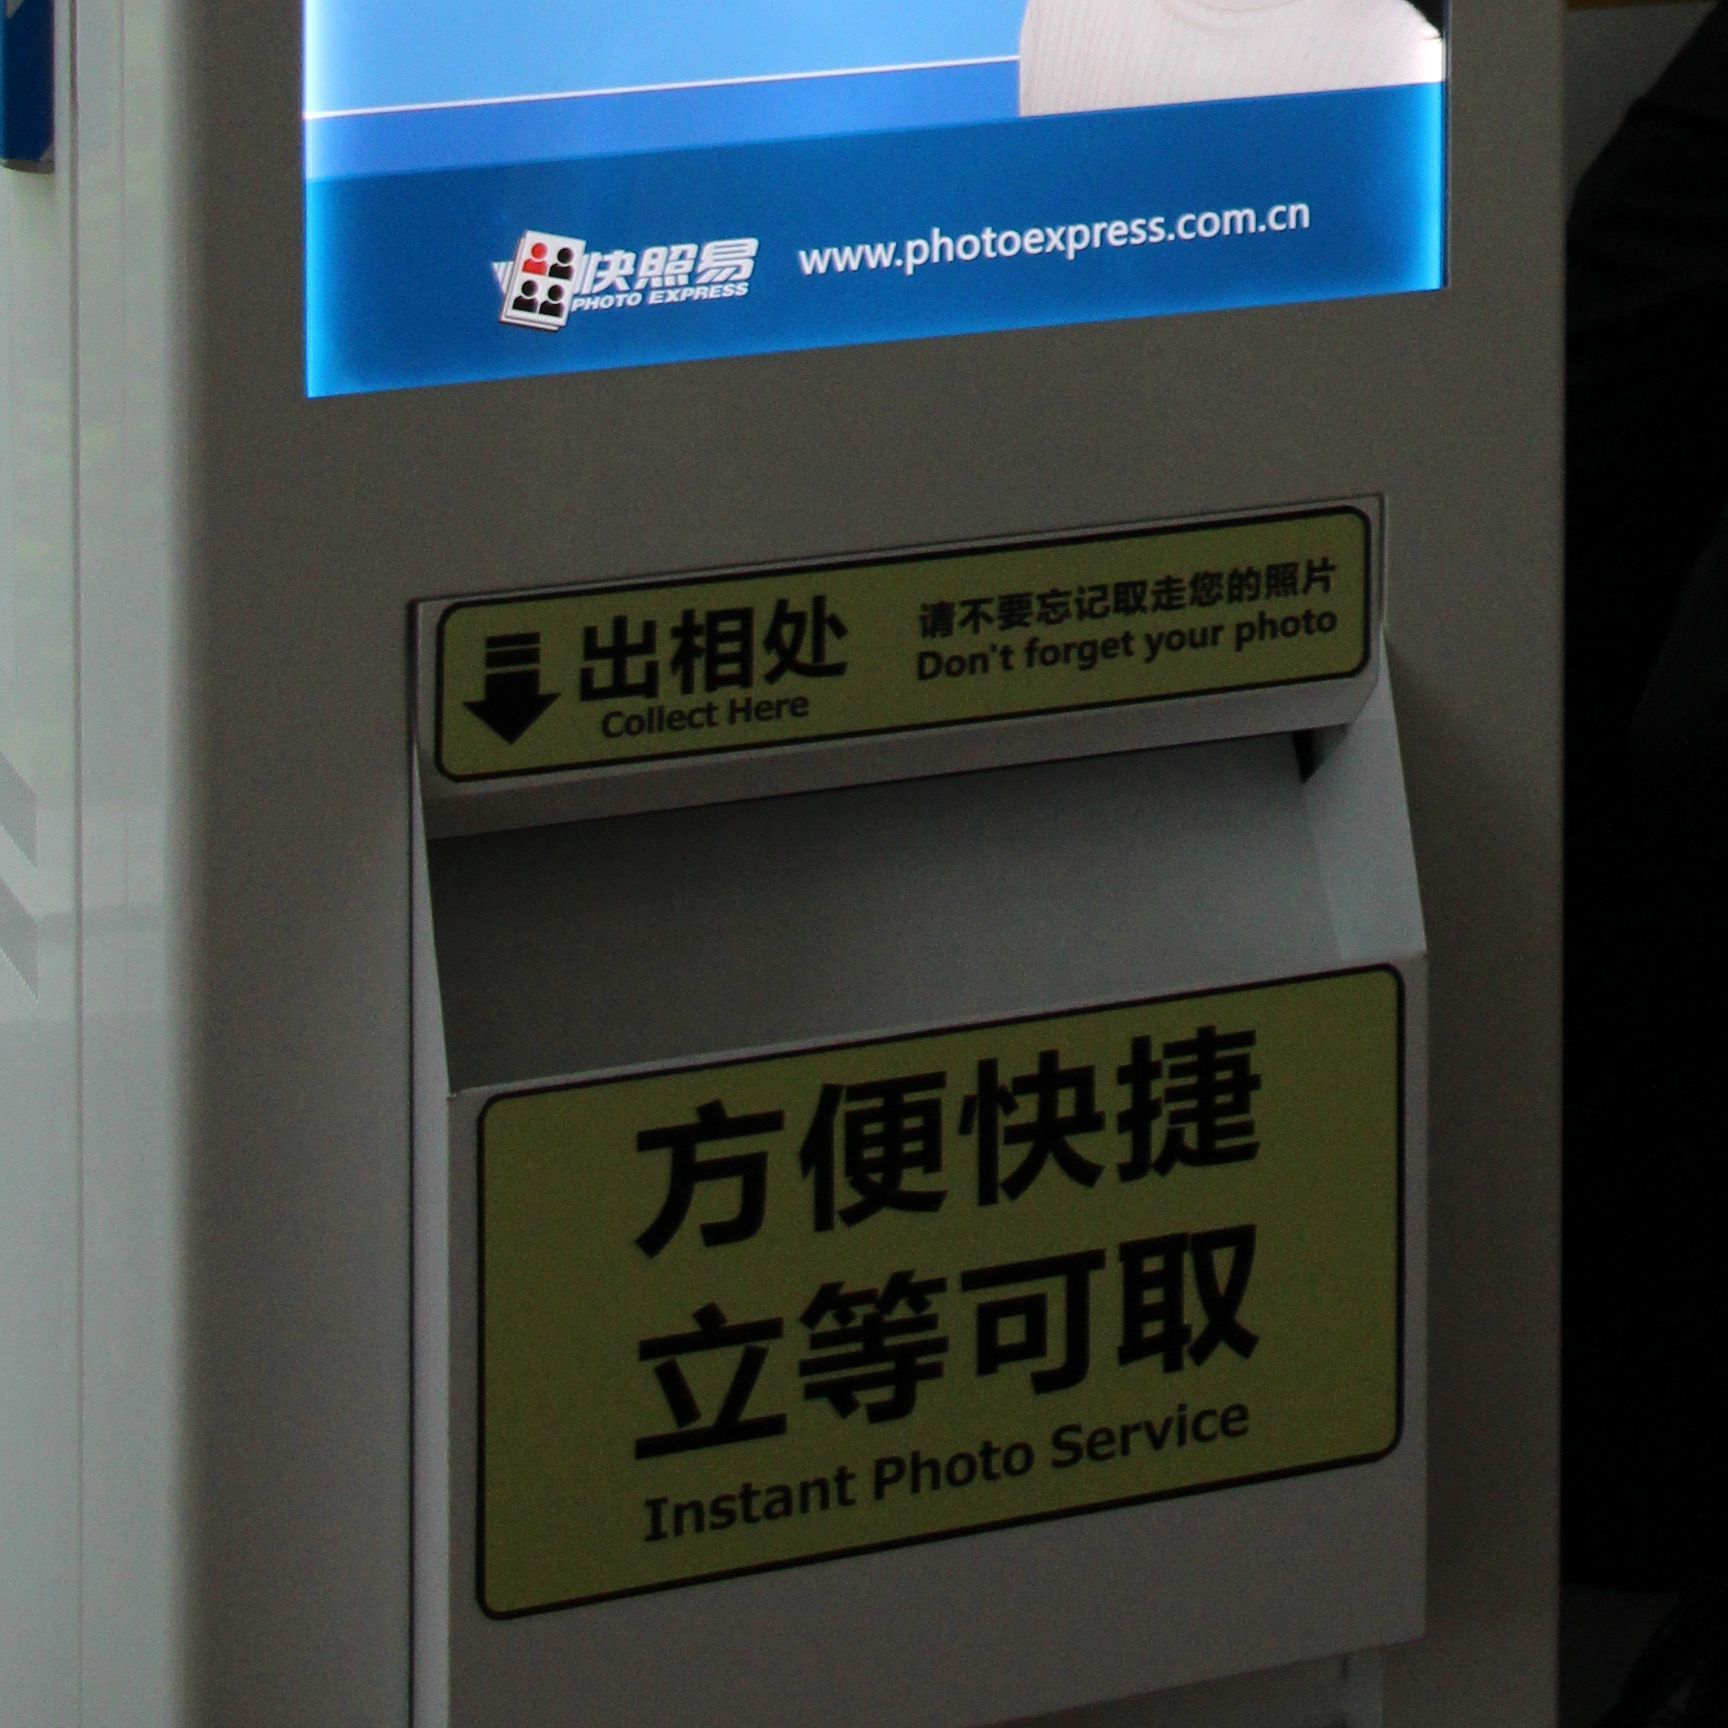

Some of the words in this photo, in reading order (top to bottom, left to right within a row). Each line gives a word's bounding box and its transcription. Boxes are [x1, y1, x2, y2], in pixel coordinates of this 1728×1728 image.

[574, 236, 760, 296] 快照易
[799, 199, 1311, 277] www.photoexpress.com.cn
[571, 291, 643, 312] PHOTO
[648, 281, 750, 306] EXPRESS
[918, 557, 1338, 642] 请不要忘记取走您的照片
[578, 594, 850, 706] 出相处
[916, 638, 1016, 684] Don't
[1025, 626, 1135, 682] forget
[1143, 624, 1226, 672] your
[1235, 604, 1339, 666] photo
[600, 697, 721, 743] Collect
[728, 690, 811, 731] Here
[633, 1024, 1263, 1260] 方便快捷
[633, 1224, 1261, 1461] 立等可取
[643, 1462, 858, 1544] Instant
[872, 1437, 1036, 1504] Photo
[1050, 1401, 1251, 1470] Service
